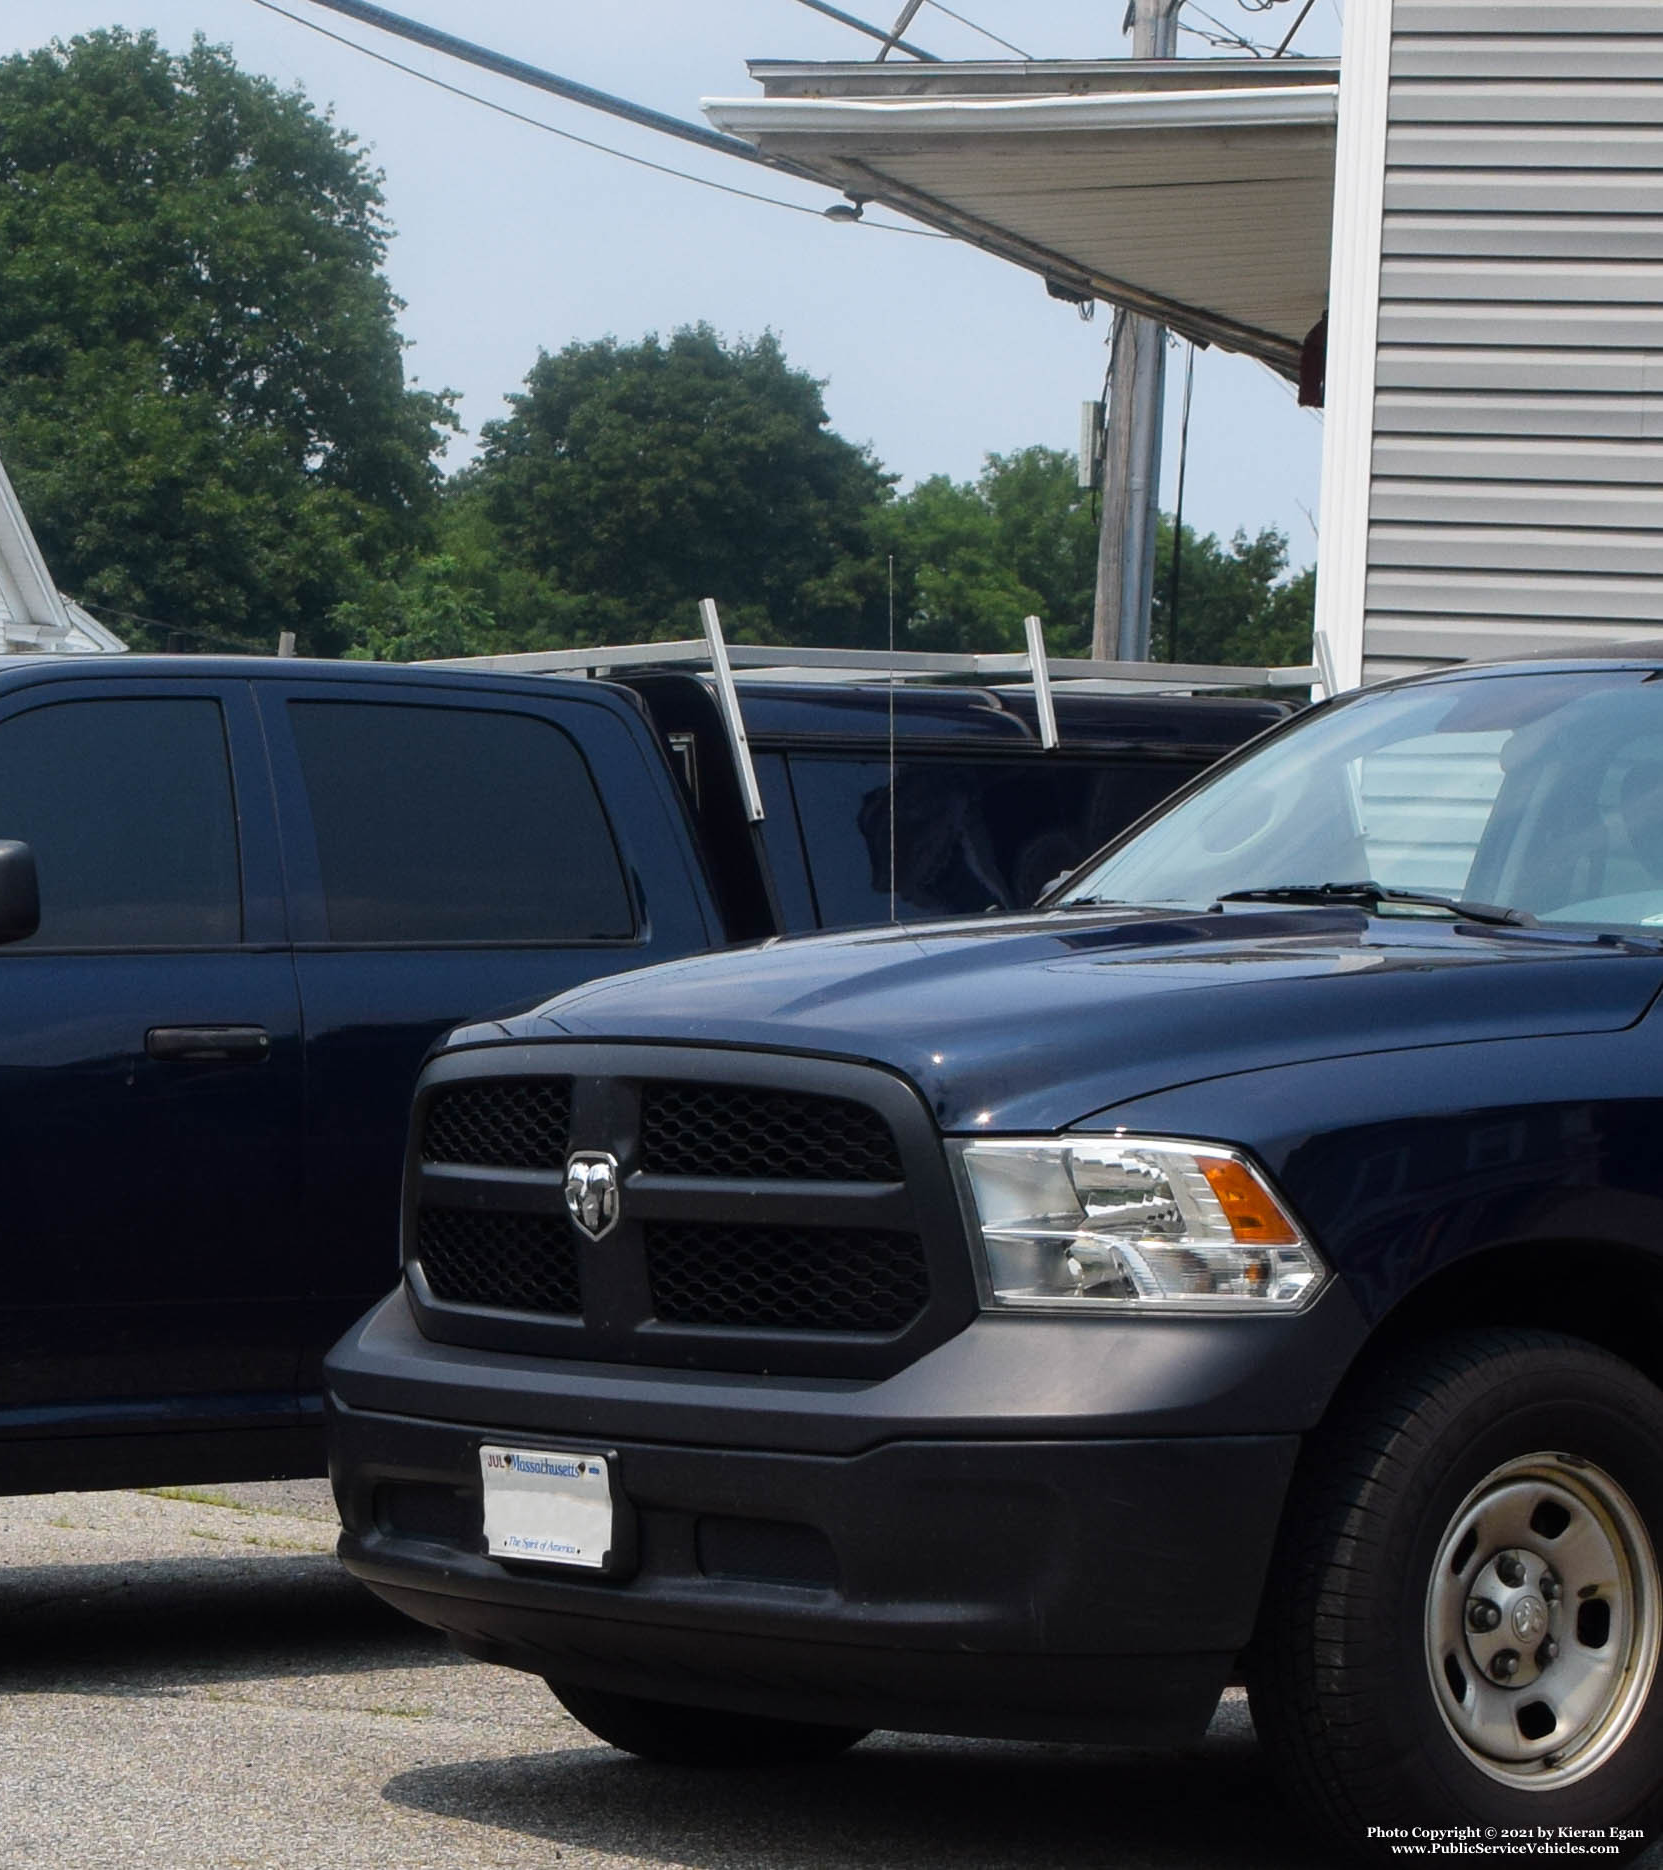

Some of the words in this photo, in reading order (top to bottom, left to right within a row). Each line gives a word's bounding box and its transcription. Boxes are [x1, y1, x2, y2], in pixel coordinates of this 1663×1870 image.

[488, 1454, 505, 1469] JUL
[510, 1454, 580, 1478] Massachusetts
[508, 1535, 520, 1546] The
[522, 1537, 538, 1550] Spirit
[541, 1540, 549, 1551] of
[548, 1541, 576, 1554] America
